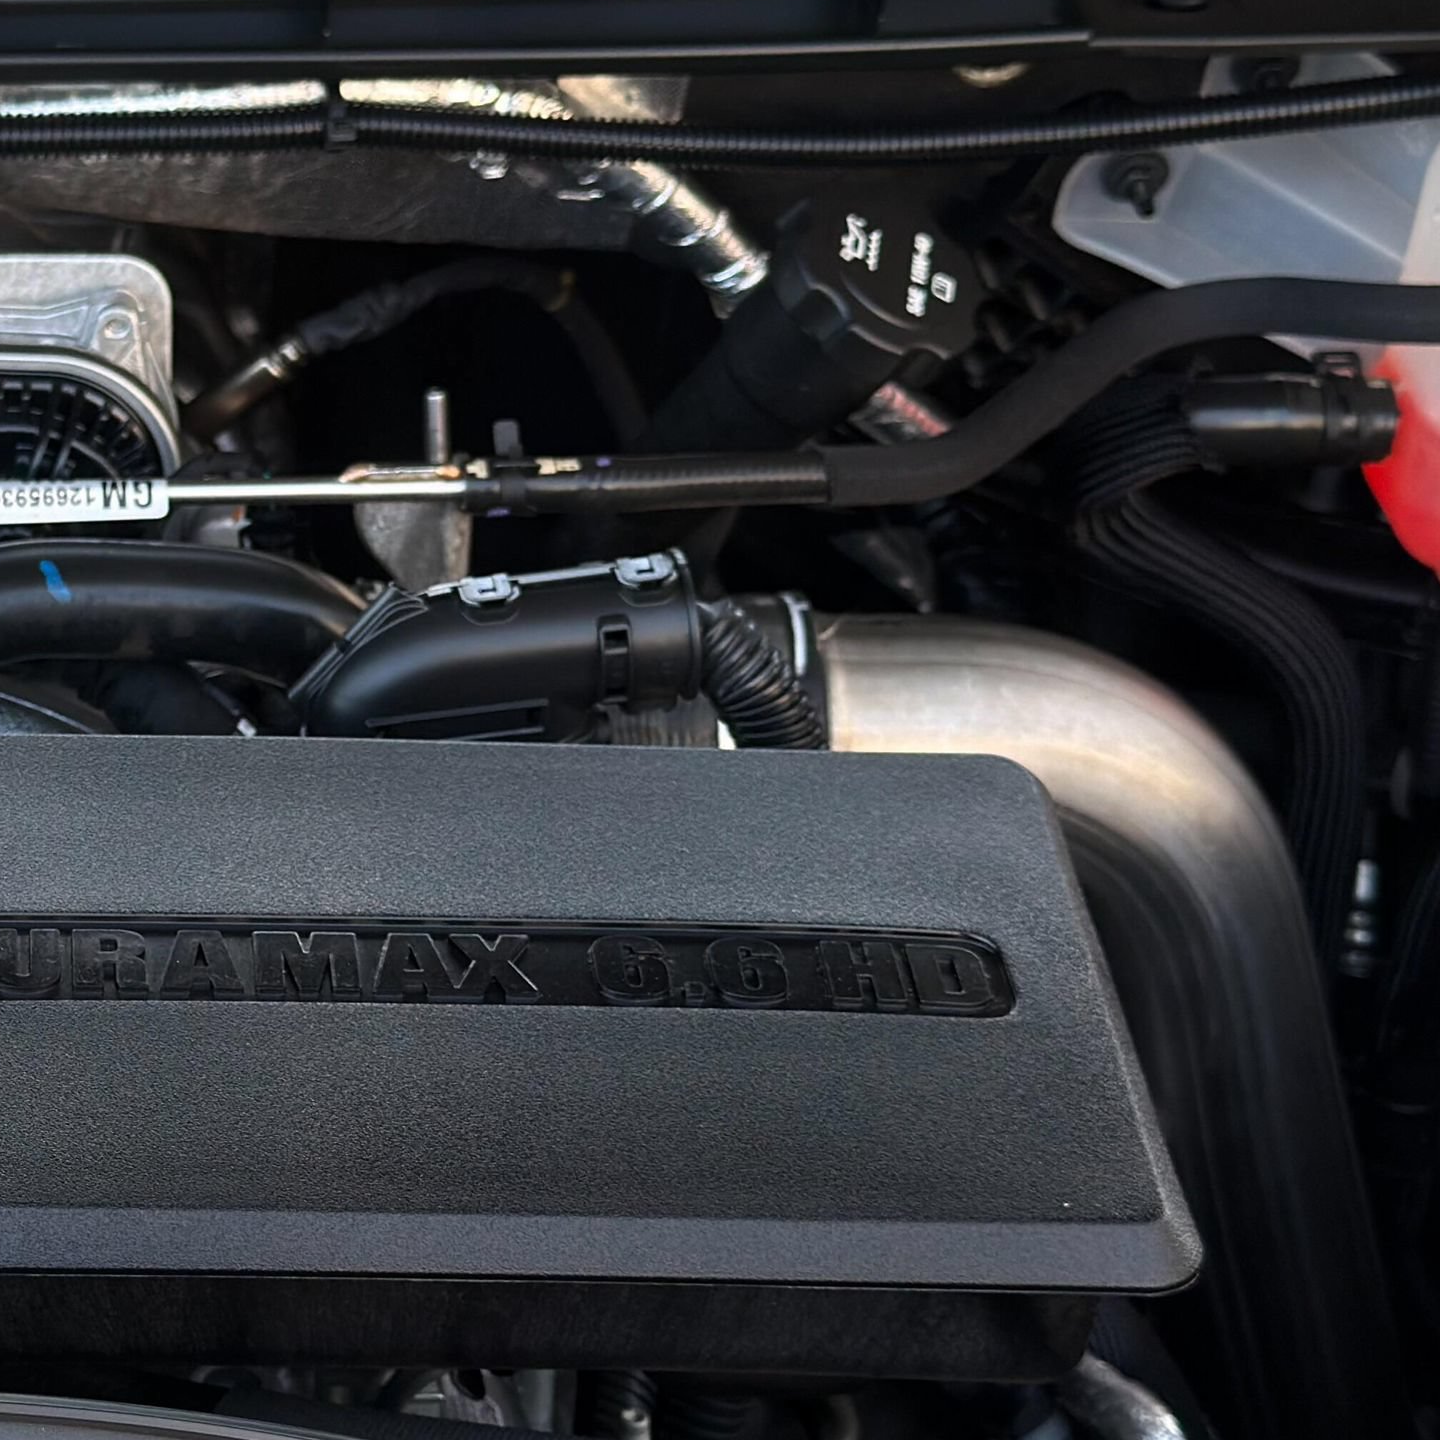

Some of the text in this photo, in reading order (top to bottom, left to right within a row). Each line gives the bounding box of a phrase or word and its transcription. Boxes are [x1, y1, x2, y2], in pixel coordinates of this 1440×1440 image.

[102, 480, 153, 509] GM
[585, 933, 797, 1009] 6.6
[817, 940, 1004, 1016] HD
